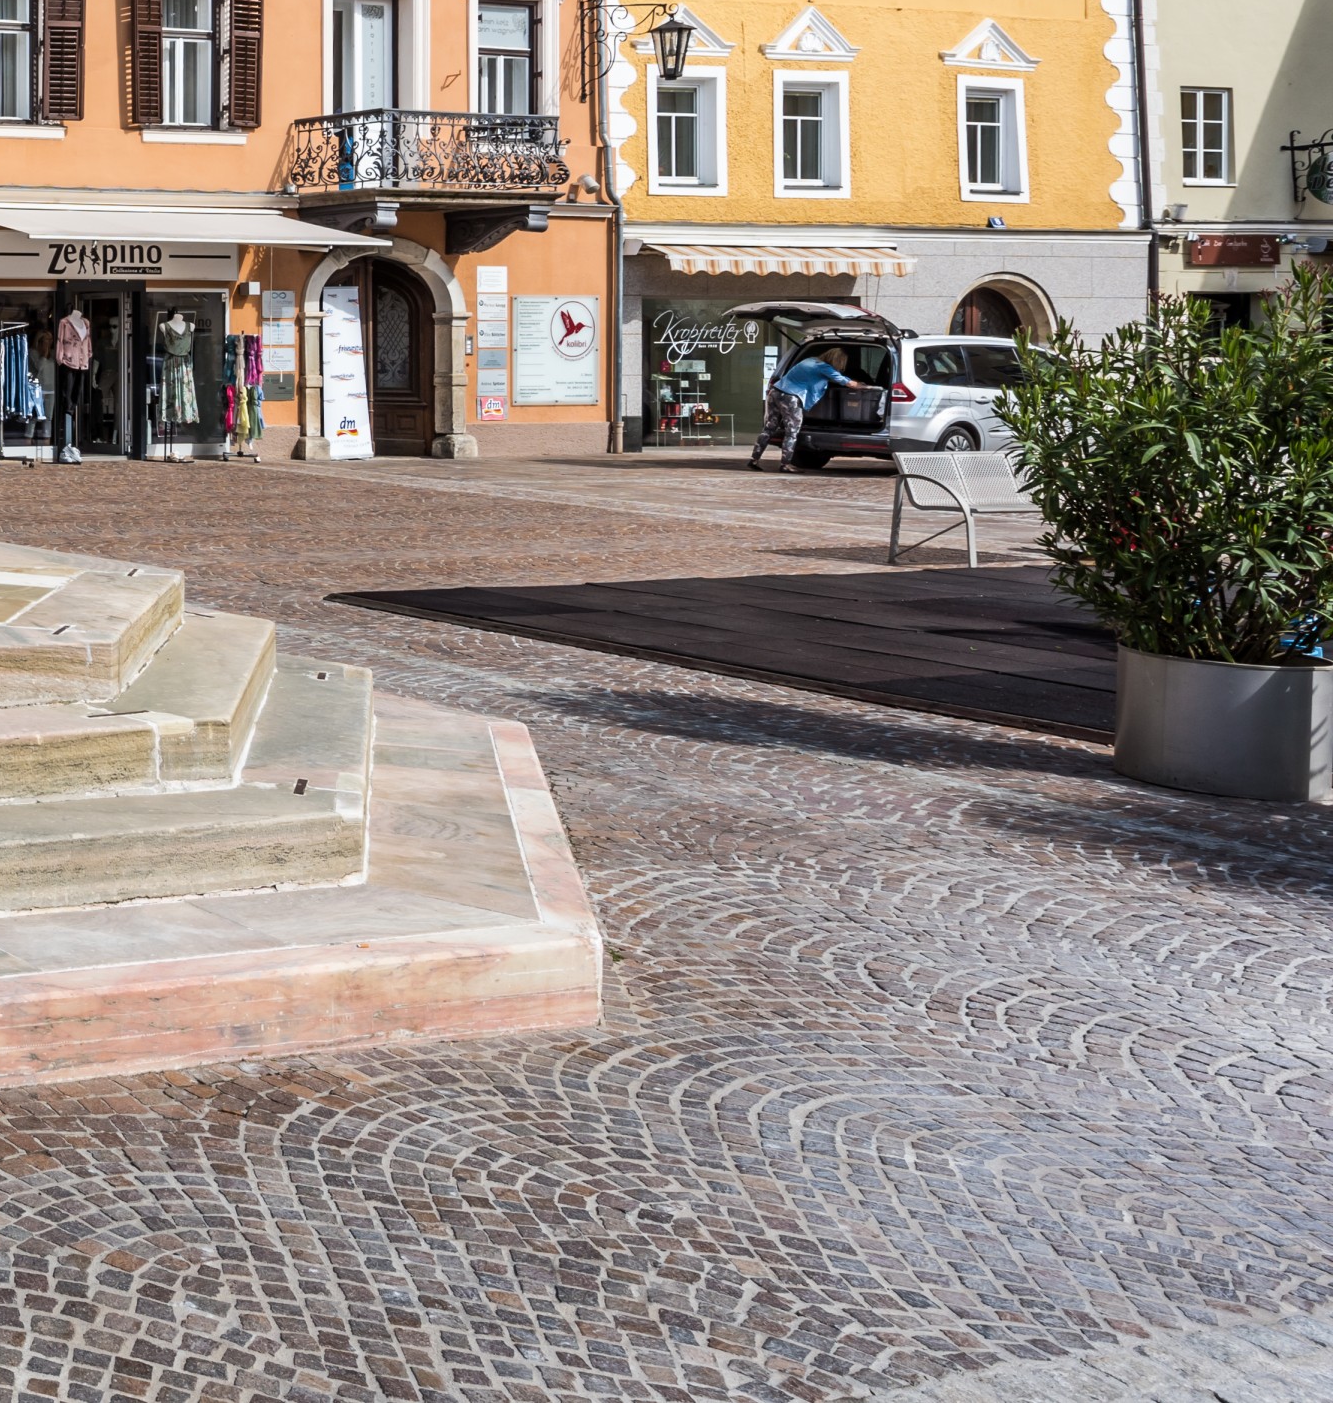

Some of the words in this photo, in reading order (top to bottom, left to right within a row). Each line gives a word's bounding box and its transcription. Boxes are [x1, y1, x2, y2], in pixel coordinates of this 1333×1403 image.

[566, 339, 587, 348] kolibri
[486, 399, 500, 409] dm
[339, 417, 356, 430] dm
